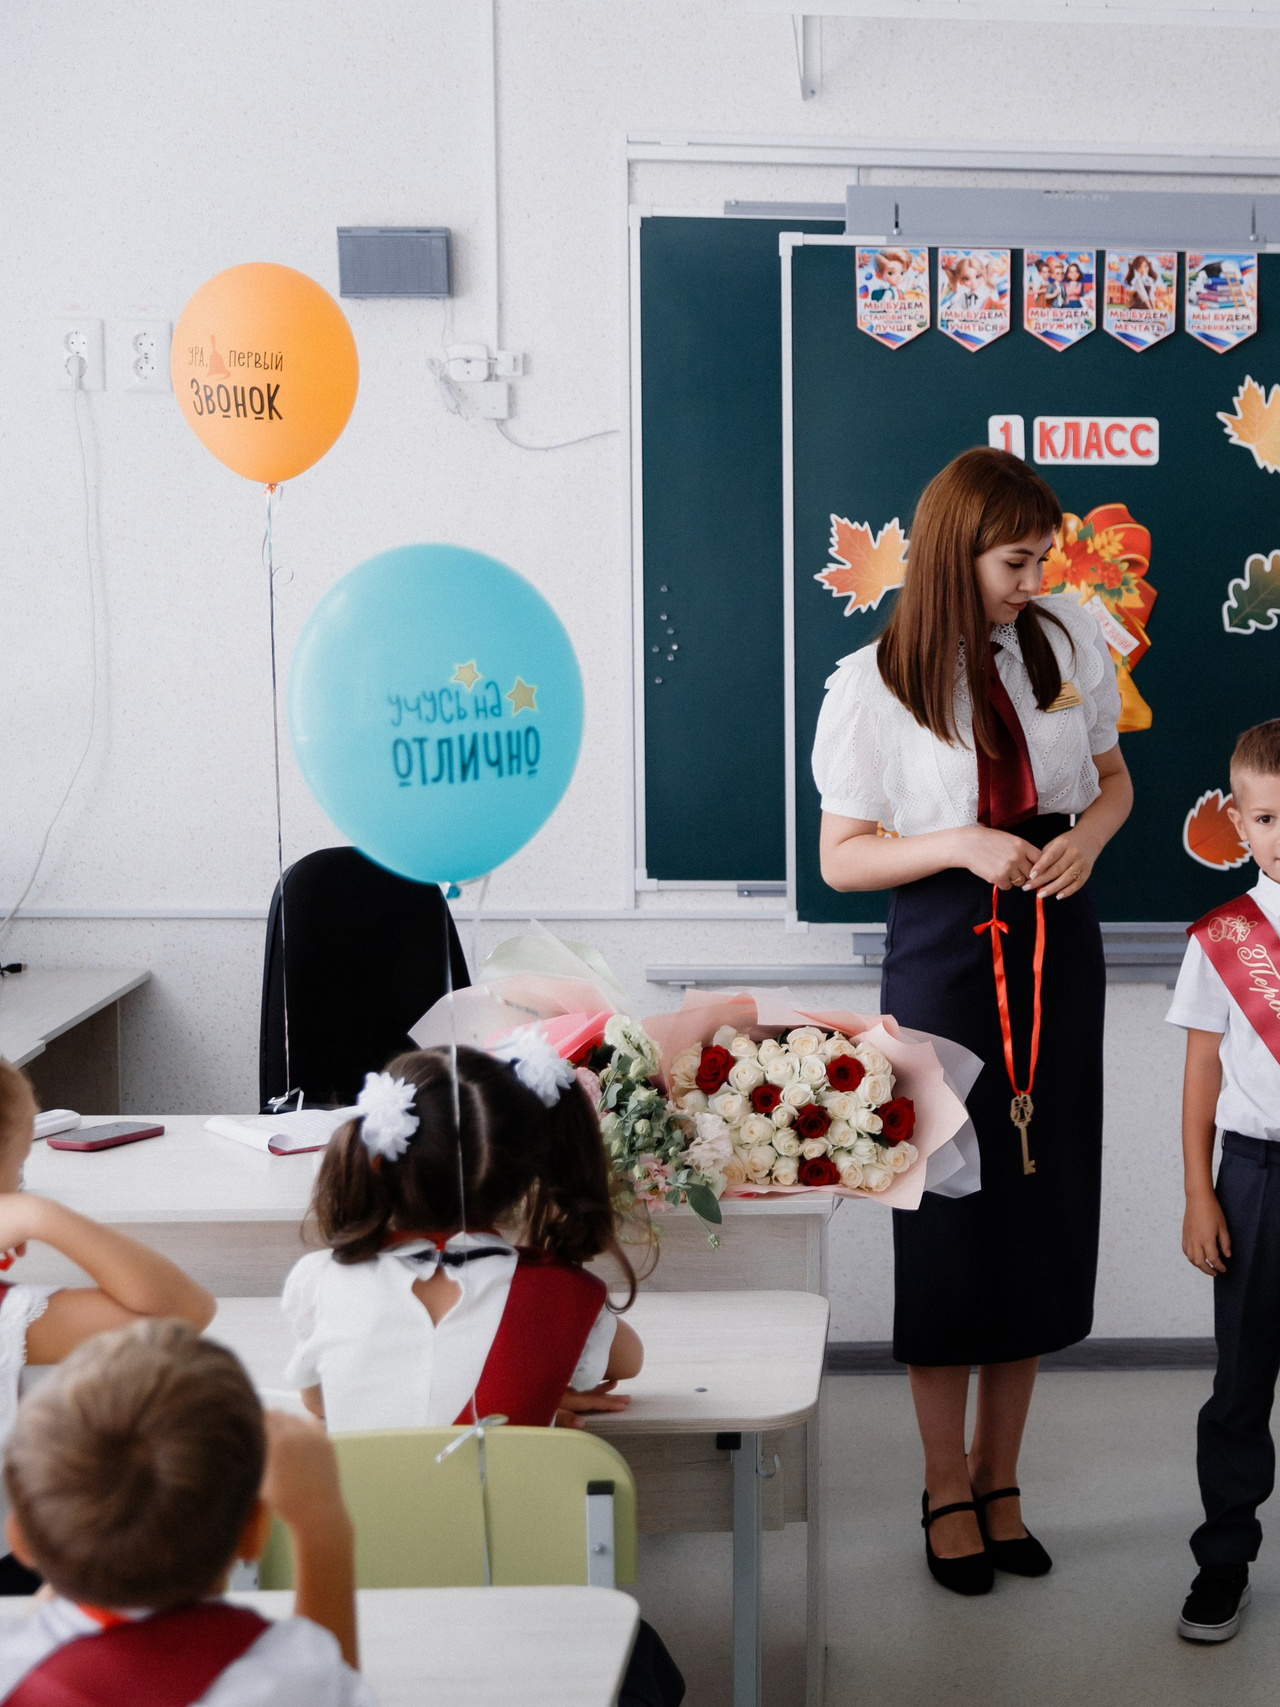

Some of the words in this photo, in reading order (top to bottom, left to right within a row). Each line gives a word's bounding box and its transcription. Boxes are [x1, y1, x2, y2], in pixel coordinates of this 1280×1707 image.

[864, 301, 883, 309] МЫ
[886, 301, 924, 310] БУДЕМ
[944, 311, 963, 319] МЫ
[965, 311, 1003, 320] БУДЕМ
[1052, 310, 1090, 318] БУДЕМ
[1110, 310, 1128, 318] МЫ
[1131, 310, 1169, 319] БУДЕМ
[1192, 313, 1211, 321] МЫ
[1213, 313, 1250, 322] БУДЕМ
[874, 324, 913, 332] ЛУЧШЕ
[949, 323, 997, 331] УЧИТЬСЯ
[1033, 323, 1086, 331] ДРУЖИТЬ
[1114, 323, 1163, 332] МЕЧТАТЬ
[190, 377, 284, 421] ЗВОНОК
[1000, 421, 1012, 454] 1
[1039, 421, 1154, 459] КЛАСС
[391, 725, 542, 788] ОТЛИЧНО
